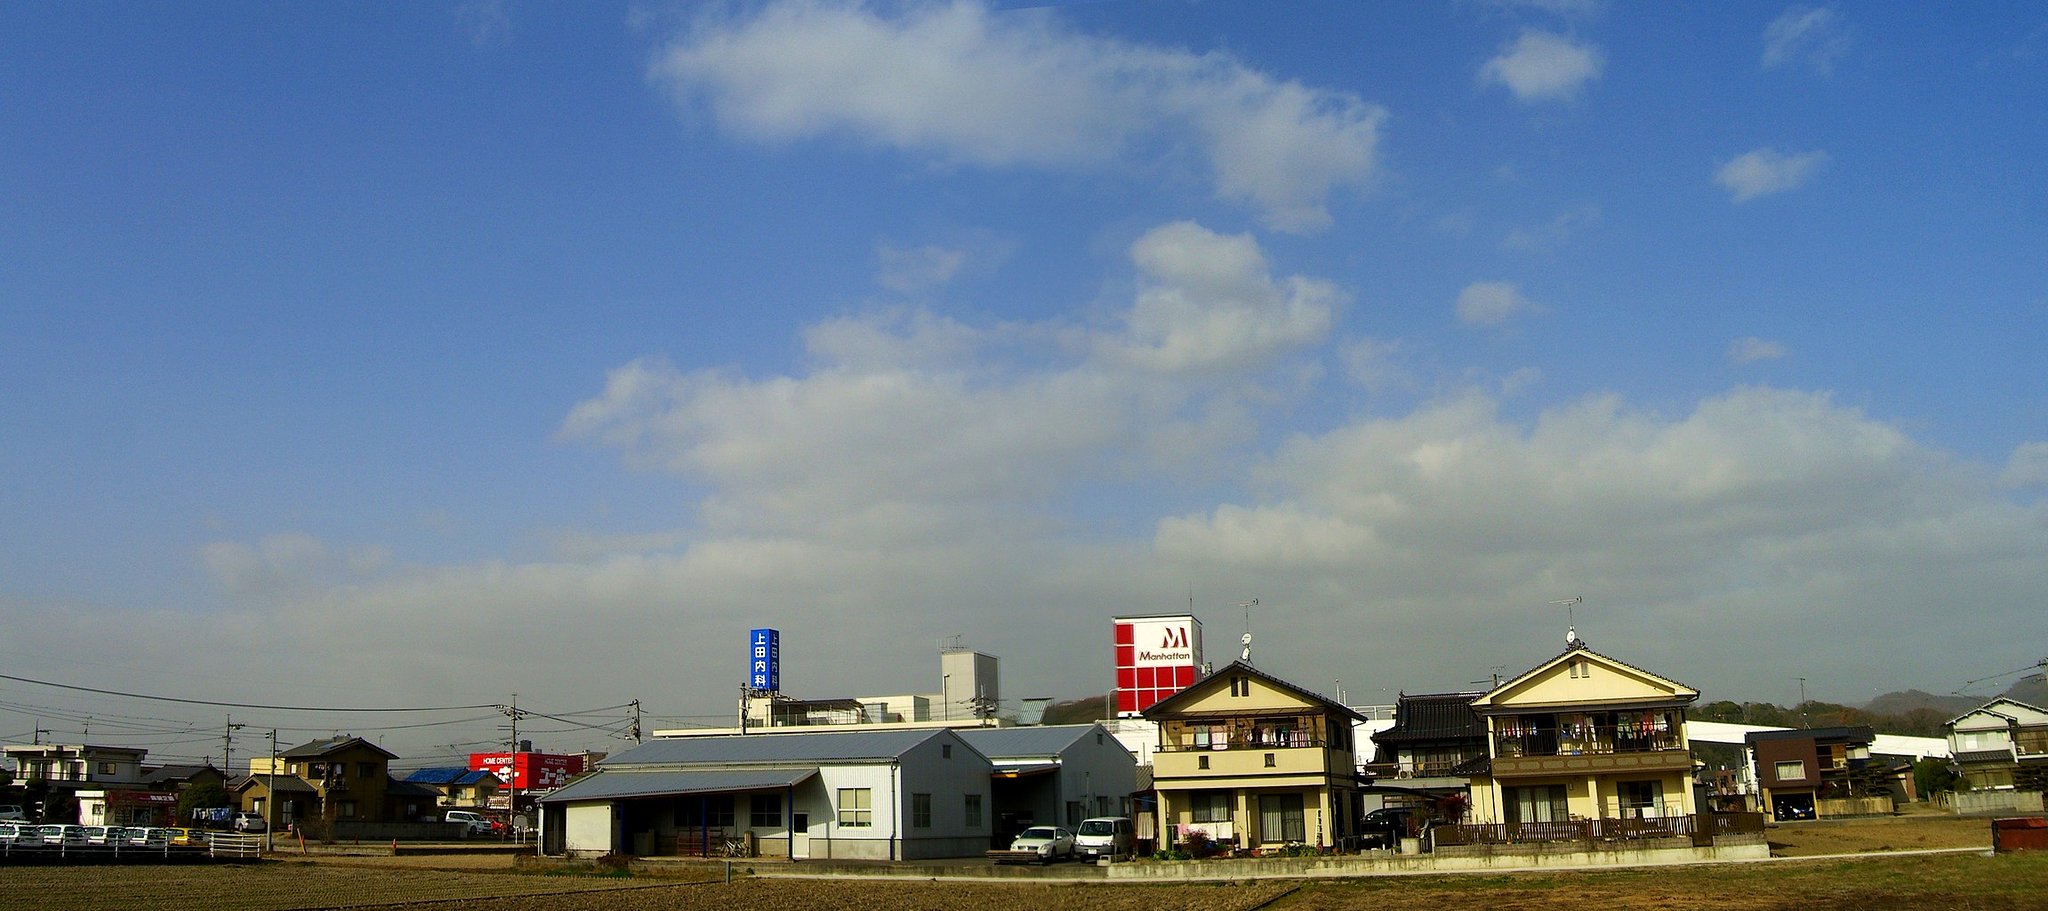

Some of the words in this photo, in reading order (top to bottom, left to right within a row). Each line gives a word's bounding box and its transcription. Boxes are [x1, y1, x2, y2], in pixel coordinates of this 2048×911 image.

[1160, 626, 1188, 648] M
[754, 632, 766, 687] 上田内科
[1139, 651, 1190, 661] Manhattan
[483, 757, 496, 765] HOME
[496, 757, 513, 765] CENTE
